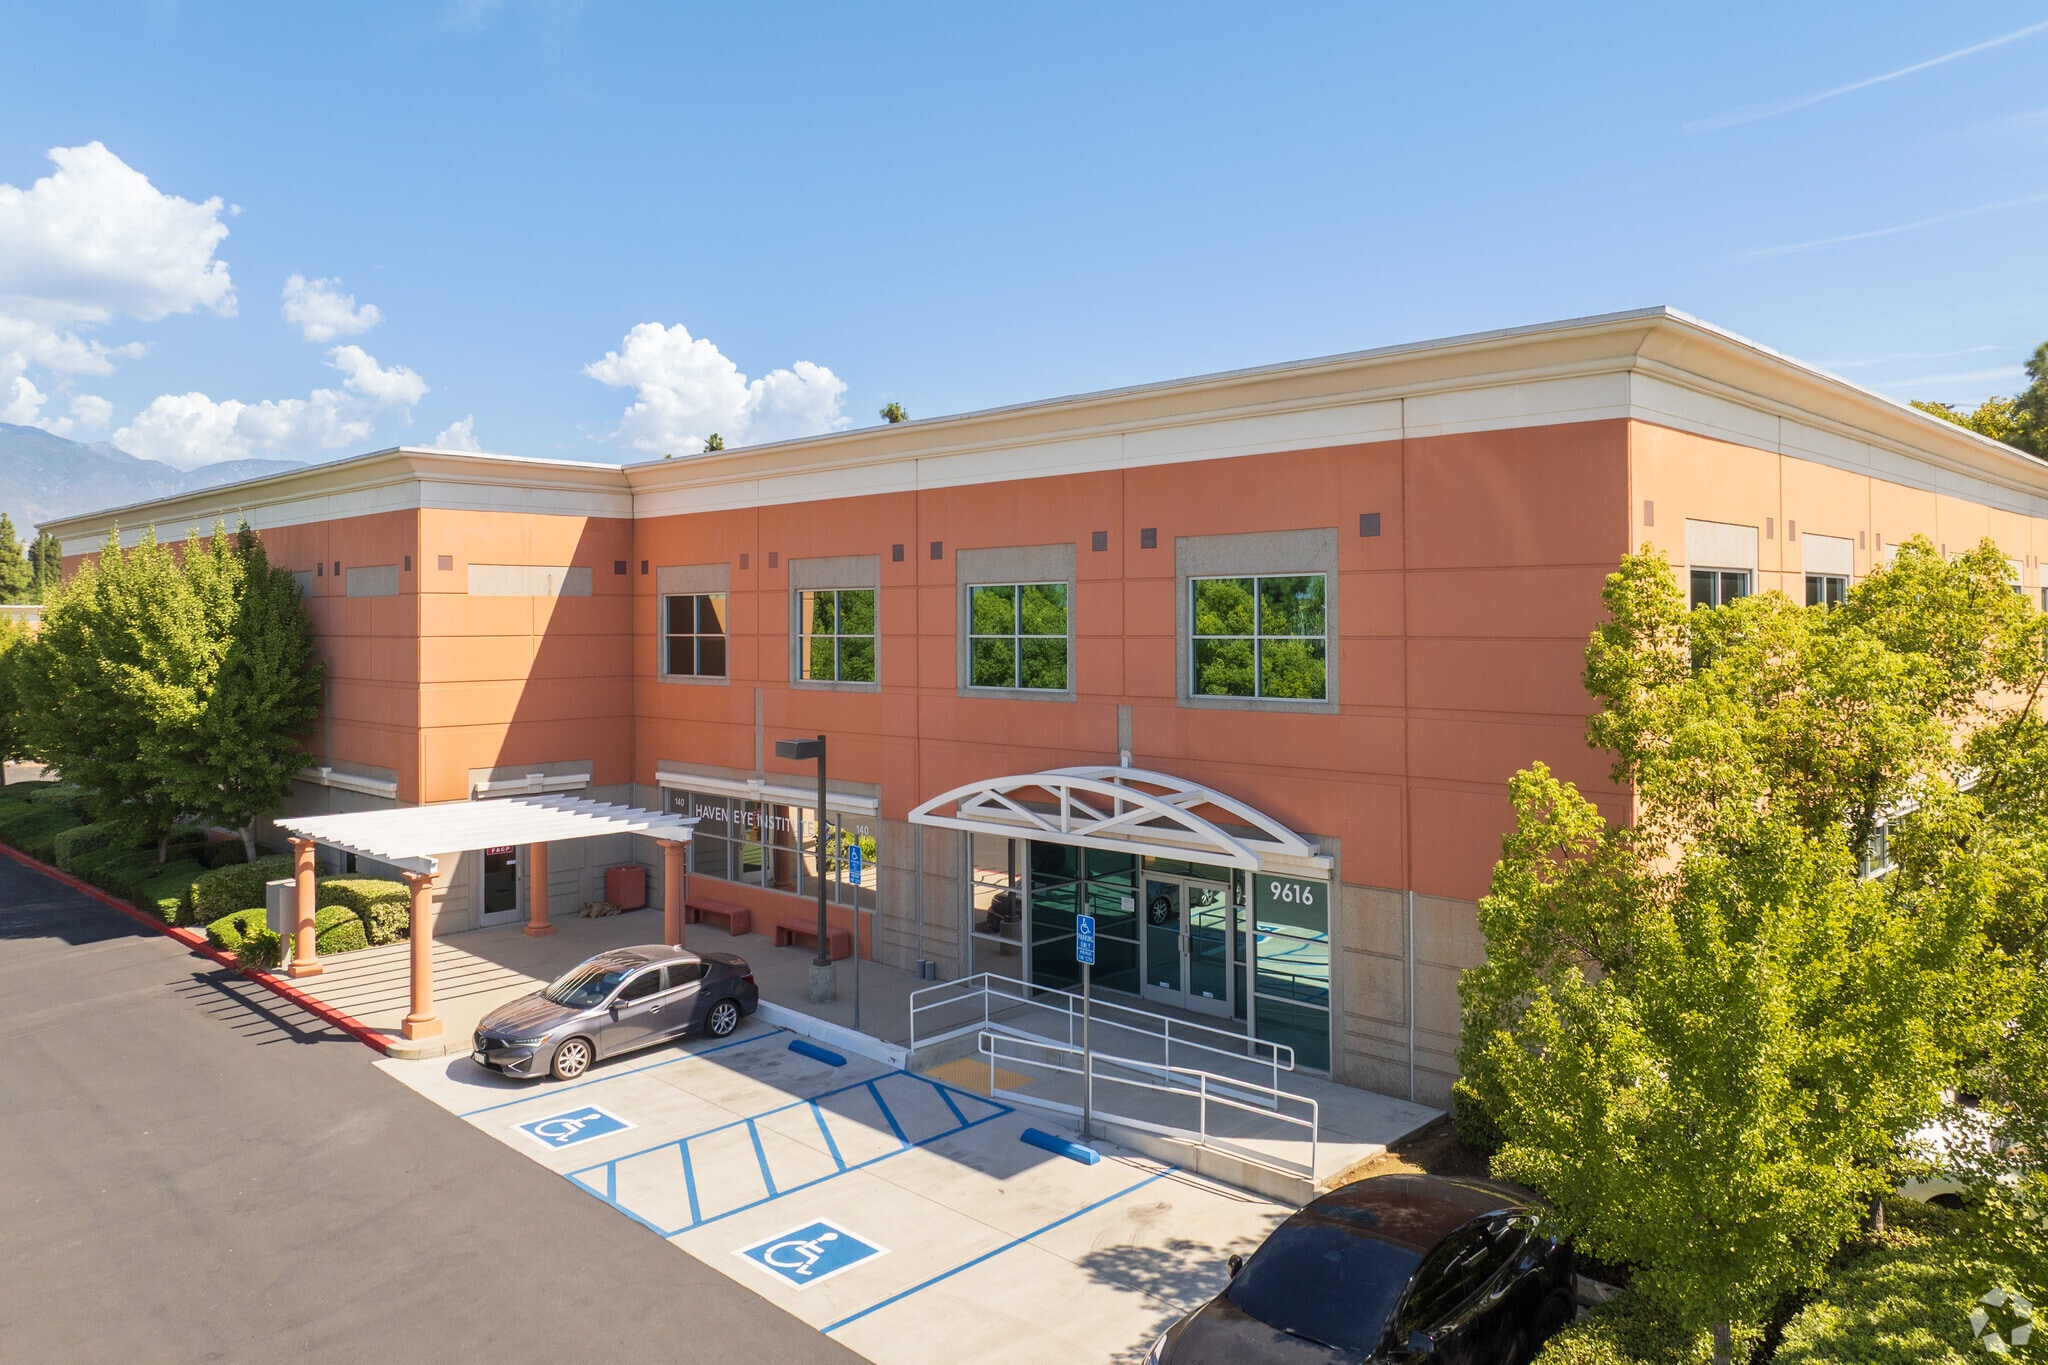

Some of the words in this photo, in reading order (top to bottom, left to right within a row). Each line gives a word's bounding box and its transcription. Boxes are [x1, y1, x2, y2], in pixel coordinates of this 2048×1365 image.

[674, 797, 685, 807] 140
[695, 804, 728, 822] HAVEN
[733, 810, 754, 827] EYE
[856, 824, 869, 835] 140
[1270, 881, 1313, 905] 9616
